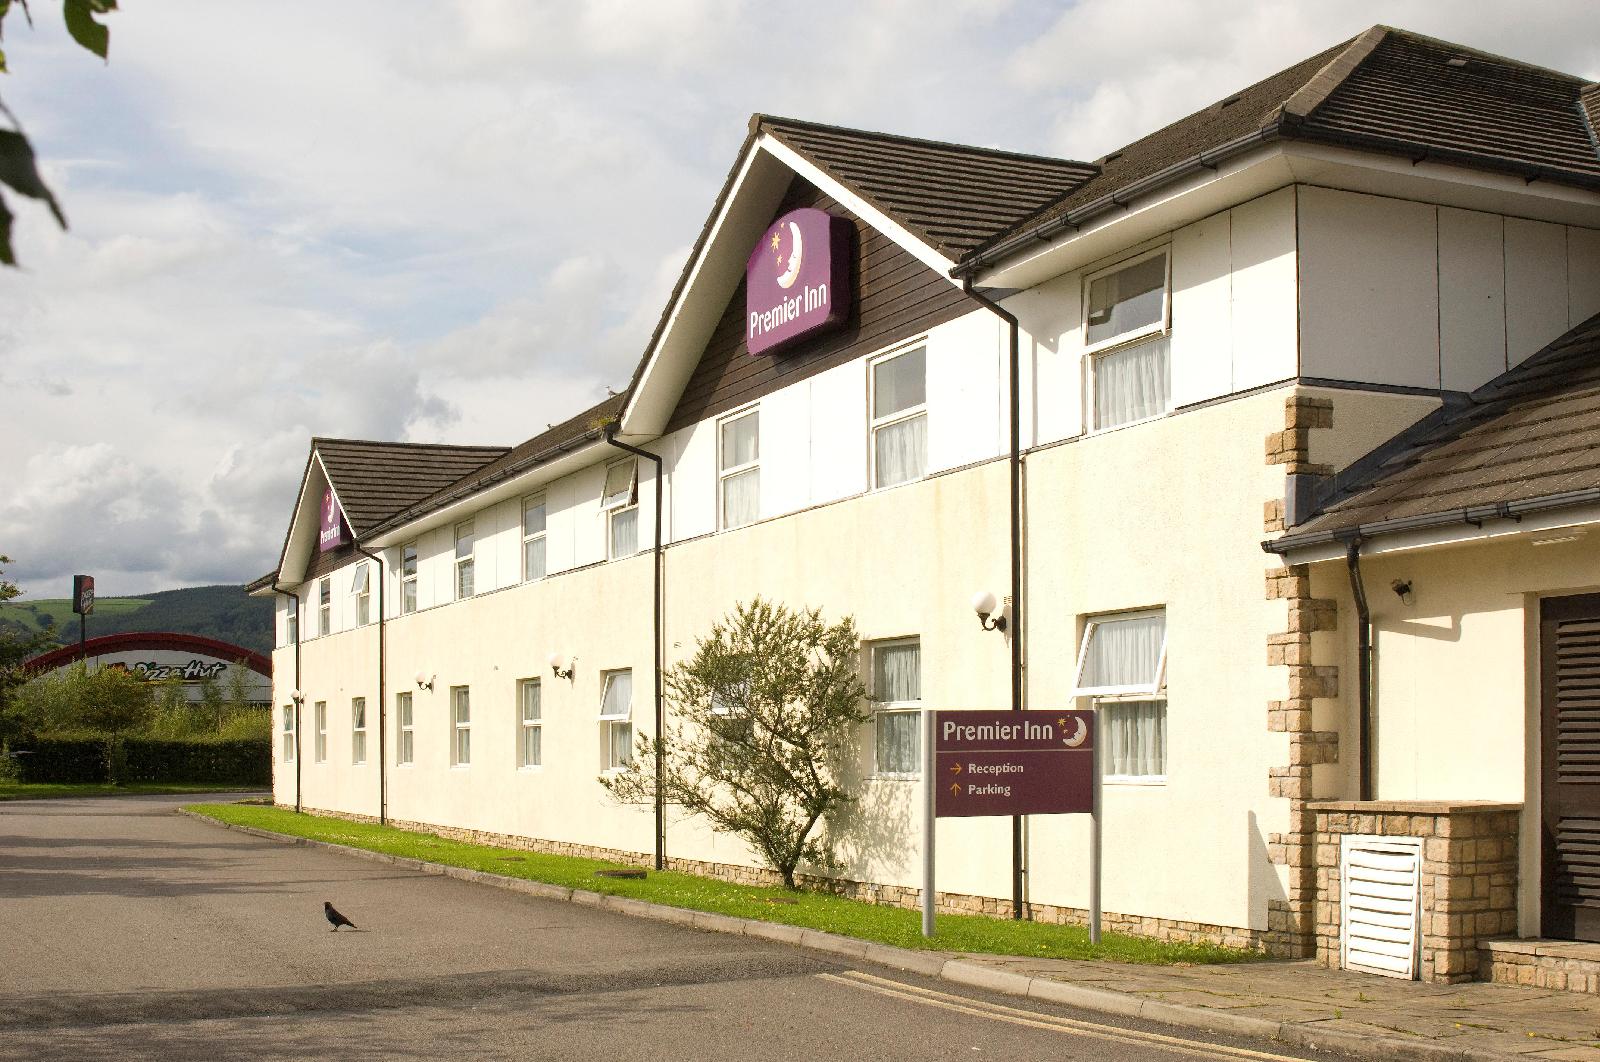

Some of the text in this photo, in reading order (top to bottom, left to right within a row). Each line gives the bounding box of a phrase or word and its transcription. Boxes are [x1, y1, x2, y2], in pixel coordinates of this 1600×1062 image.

[750, 283, 827, 339] Premier Inn
[184, 660, 223, 679] Hut
[943, 720, 1053, 741] Premier Inn
[968, 762, 1024, 776] Reception
[968, 783, 1011, 797] Parking
